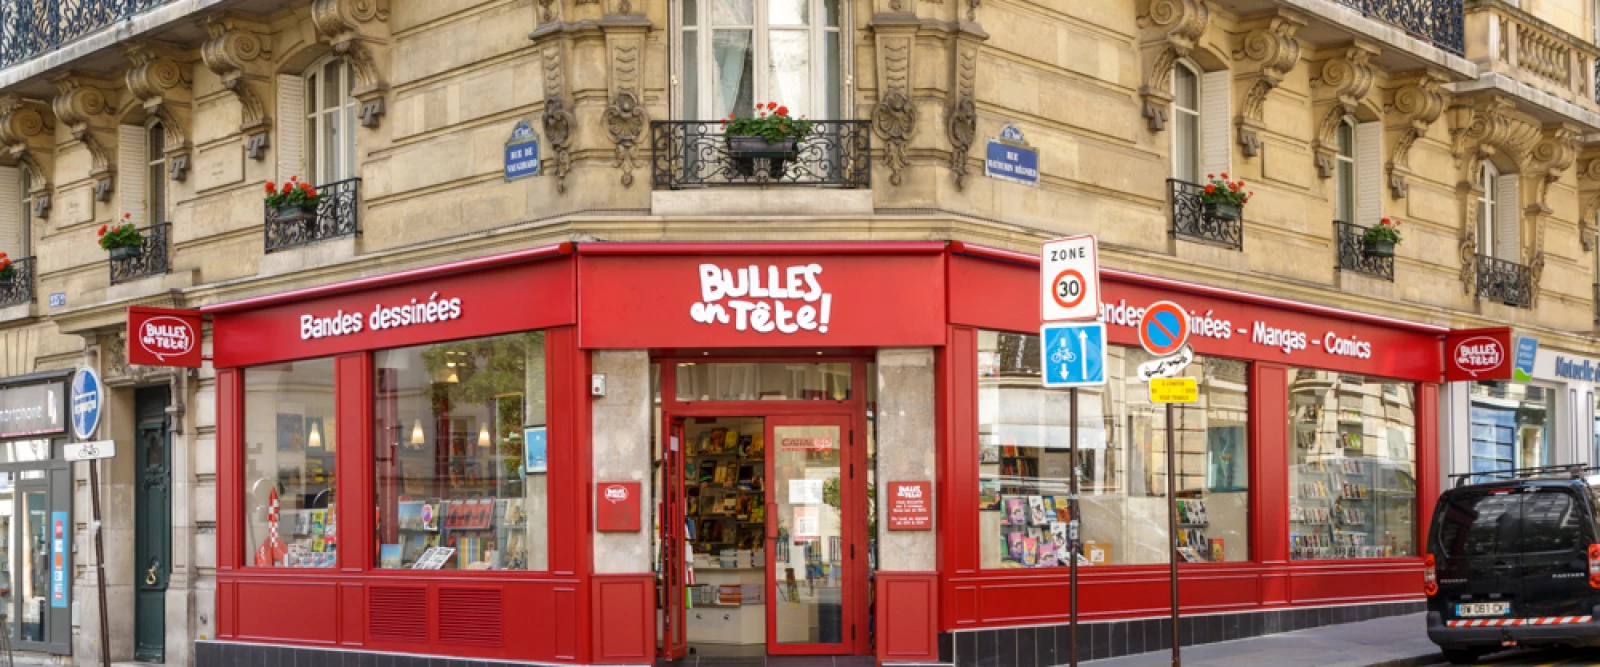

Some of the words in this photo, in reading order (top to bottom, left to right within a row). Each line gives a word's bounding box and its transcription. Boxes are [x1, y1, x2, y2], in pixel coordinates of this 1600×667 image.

[1051, 246, 1086, 262] ZONE
[699, 263, 823, 302] BULLES
[1059, 280, 1080, 298] 30
[300, 309, 363, 340] Bandes
[369, 291, 462, 331] dessinées
[690, 301, 730, 324] en
[146, 323, 186, 338] BULLES
[1098, 299, 1145, 326] andes
[1188, 310, 1231, 339] inées
[1253, 321, 1307, 354] Mangas
[1324, 332, 1371, 359] Comics
[1460, 343, 1496, 356] BULLES
